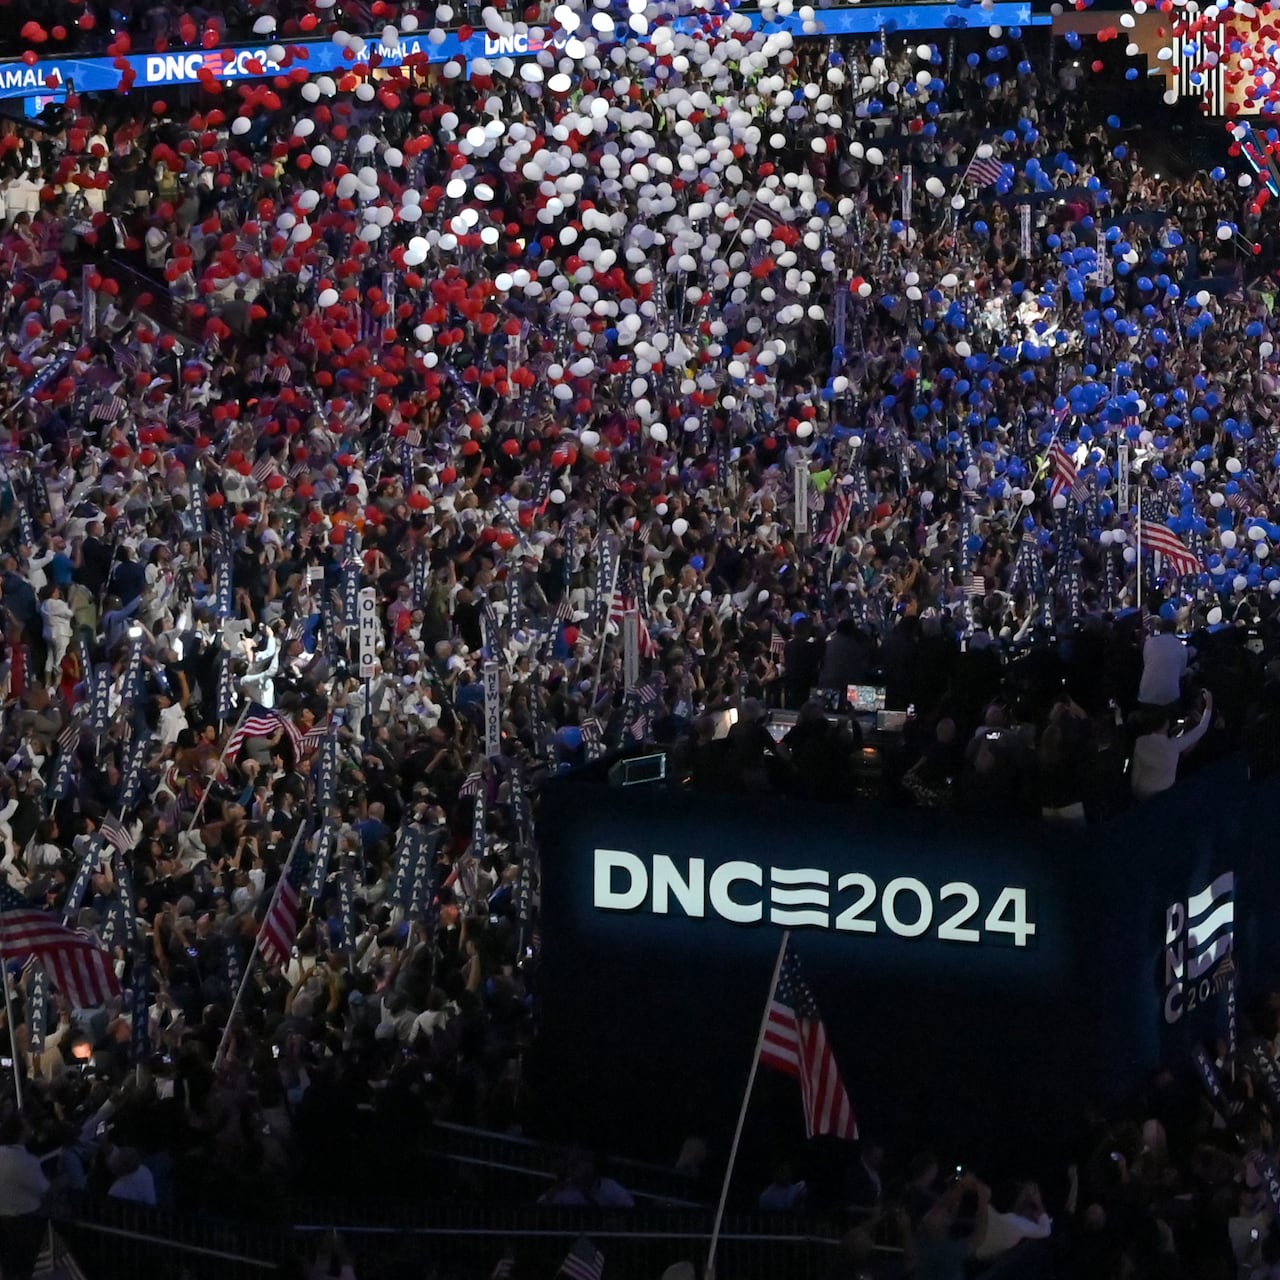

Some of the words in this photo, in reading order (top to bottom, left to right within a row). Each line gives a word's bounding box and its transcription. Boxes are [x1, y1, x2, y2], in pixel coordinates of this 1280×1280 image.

[219, 561, 230, 613] KAMALA
[346, 572, 357, 620] KAMALA
[602, 540, 612, 593] KAMALA
[362, 599, 374, 666] OHIO
[95, 670, 107, 730] KAMALA
[126, 642, 142, 700] KAMALA
[219, 657, 229, 714] KAMALA
[487, 669, 498, 702] NEW
[487, 706, 499, 745] YORK
[120, 740, 145, 799] KAMALA
[321, 748, 331, 803] KAMALA
[511, 767, 524, 821] KAMALA
[475, 788, 485, 853] KAMALA
[67, 842, 98, 910] KAMALA
[416, 842, 431, 912] KAMALA
[519, 856, 531, 922] KAMALA
[593, 849, 763, 925] DNC
[836, 873, 1036, 947] 2024
[119, 876, 135, 941] KAMALA
[339, 880, 352, 950] KAMALA
[31, 972, 45, 1046] KAMALA
[1226, 978, 1237, 1054] KAMALA
